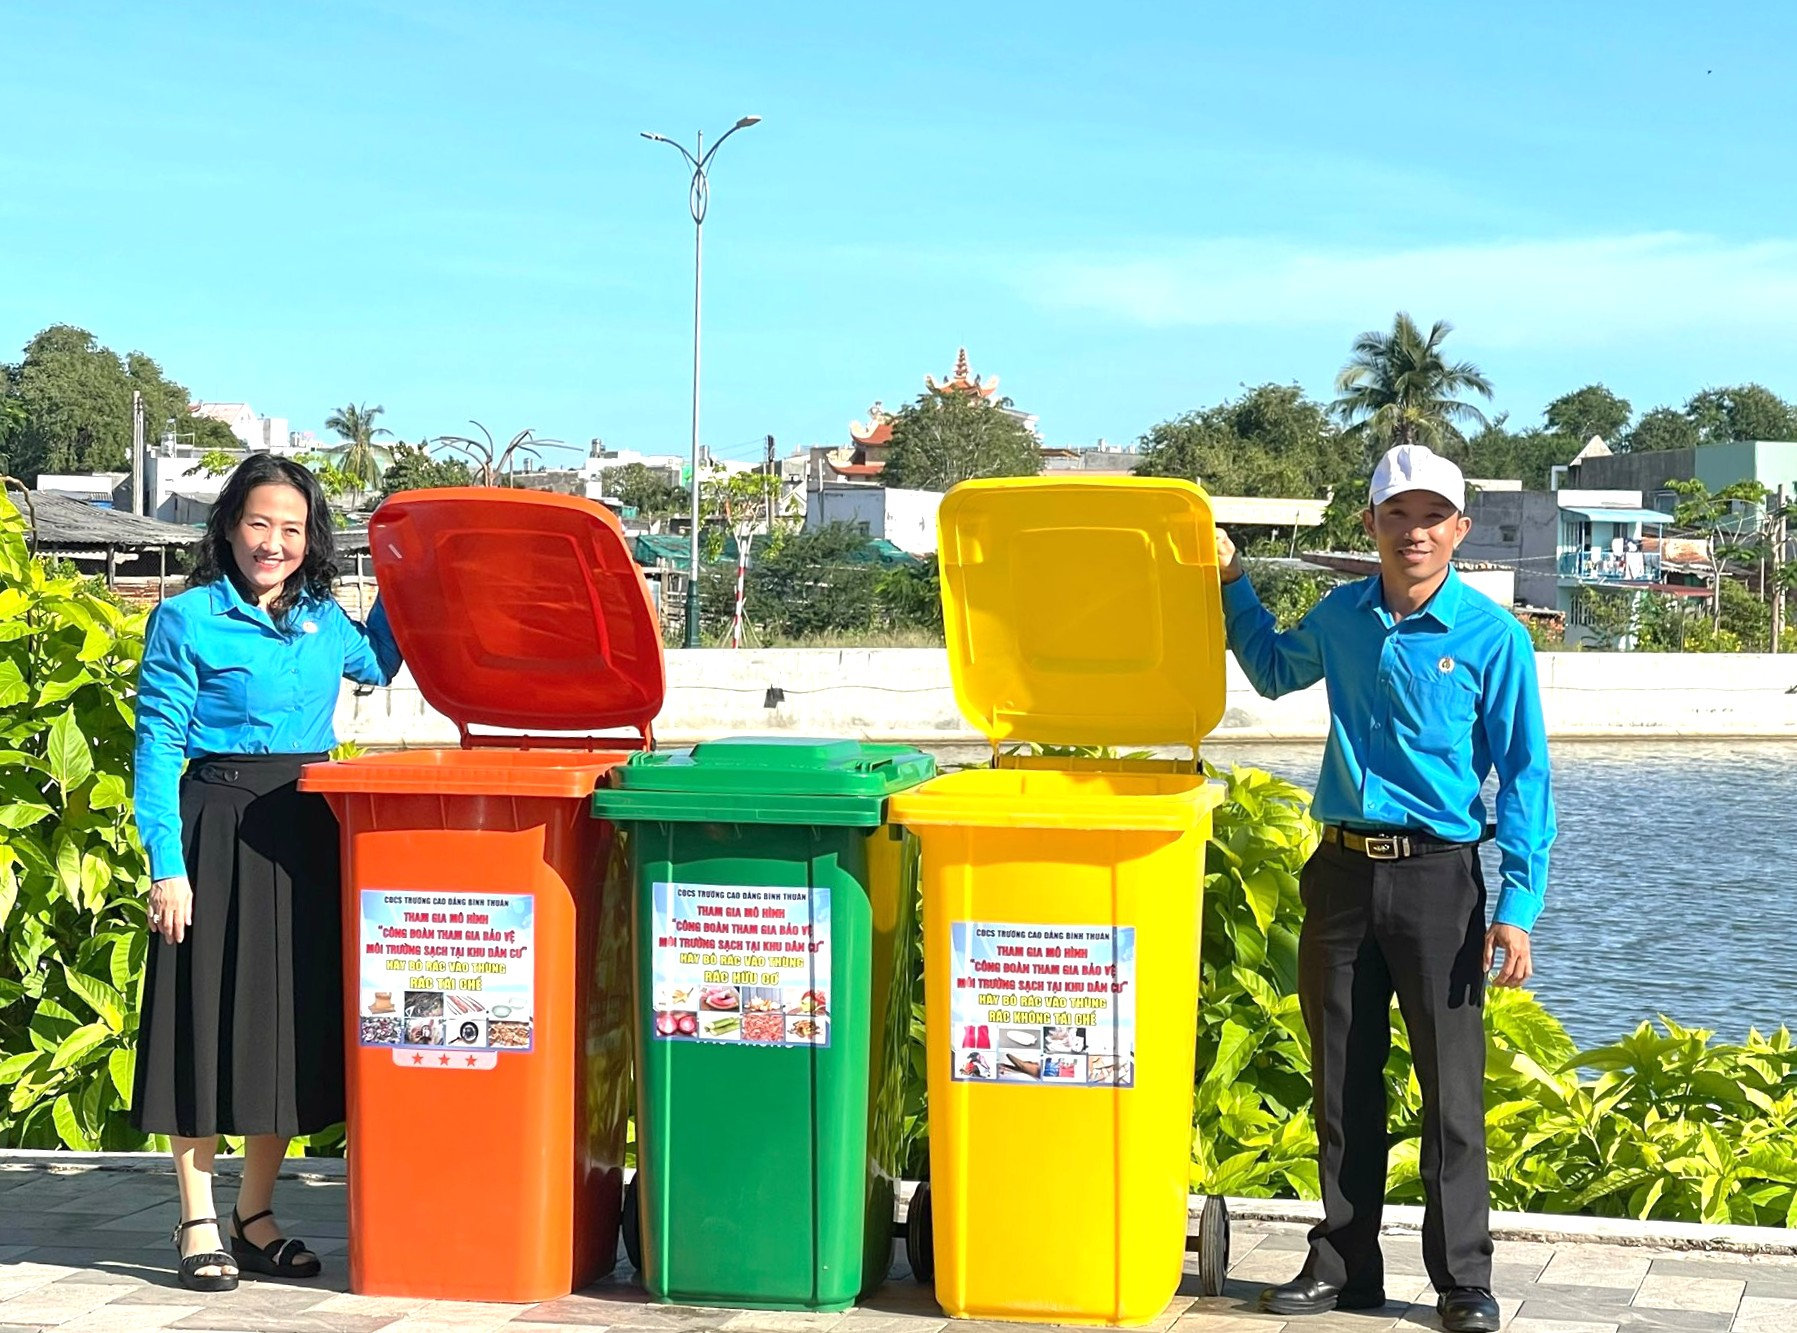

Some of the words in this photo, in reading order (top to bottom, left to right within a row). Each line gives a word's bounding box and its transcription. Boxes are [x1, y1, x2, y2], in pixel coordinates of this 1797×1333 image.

[433, 897, 446, 905] CAO
[727, 891, 740, 899] CAO
[404, 912, 429, 922] THAM
[432, 913, 446, 923] GIA
[450, 912, 464, 923] MÔ
[467, 913, 488, 924] HÌNH
[697, 906, 723, 917] THAM
[726, 907, 740, 917] GIA
[744, 906, 759, 918] MÔ
[762, 906, 785, 918] HÌNH
[732, 924, 758, 934] THAM
[761, 925, 776, 935] GIA
[1028, 931, 1042, 939] CAO
[437, 930, 462, 940] THAM
[465, 930, 480, 940] GIA
[504, 930, 515, 943] VỆ
[659, 936, 677, 947] MÔI
[680, 937, 715, 949] TRƯỜNG
[718, 940, 743, 952] SẠCH
[746, 941, 760, 953] TẠI
[763, 941, 782, 951] KHU
[785, 941, 804, 952] DÂN
[366, 944, 383, 953] MÔI
[386, 943, 421, 955] TRƯỜNG
[424, 946, 448, 959] SẠCH
[451, 947, 464, 959] TẠI
[467, 947, 485, 956] KHU
[488, 946, 507, 957] DÂN
[997, 946, 1023, 957] THAM
[1027, 947, 1042, 957] GIA
[1046, 946, 1061, 958] MÔ
[1064, 947, 1088, 958] HÌNH
[720, 953, 741, 966] RÁC
[425, 960, 446, 972] RÁC
[1032, 964, 1060, 975] THAM
[1063, 965, 1078, 975] GIA
[410, 976, 433, 989] RÁC
[704, 970, 729, 983] RÁC
[957, 977, 975, 988] MÔI
[978, 977, 1015, 989] TRƯỜNG
[1018, 980, 1043, 993] SẠCH
[1047, 981, 1062, 994] TẠI
[1065, 982, 1084, 992] KHU
[1087, 981, 1107, 992] DÂN
[1020, 995, 1042, 1007] RÁC
[988, 1009, 1010, 1023] RÁC
[1013, 1010, 1051, 1025] KHÔNG
